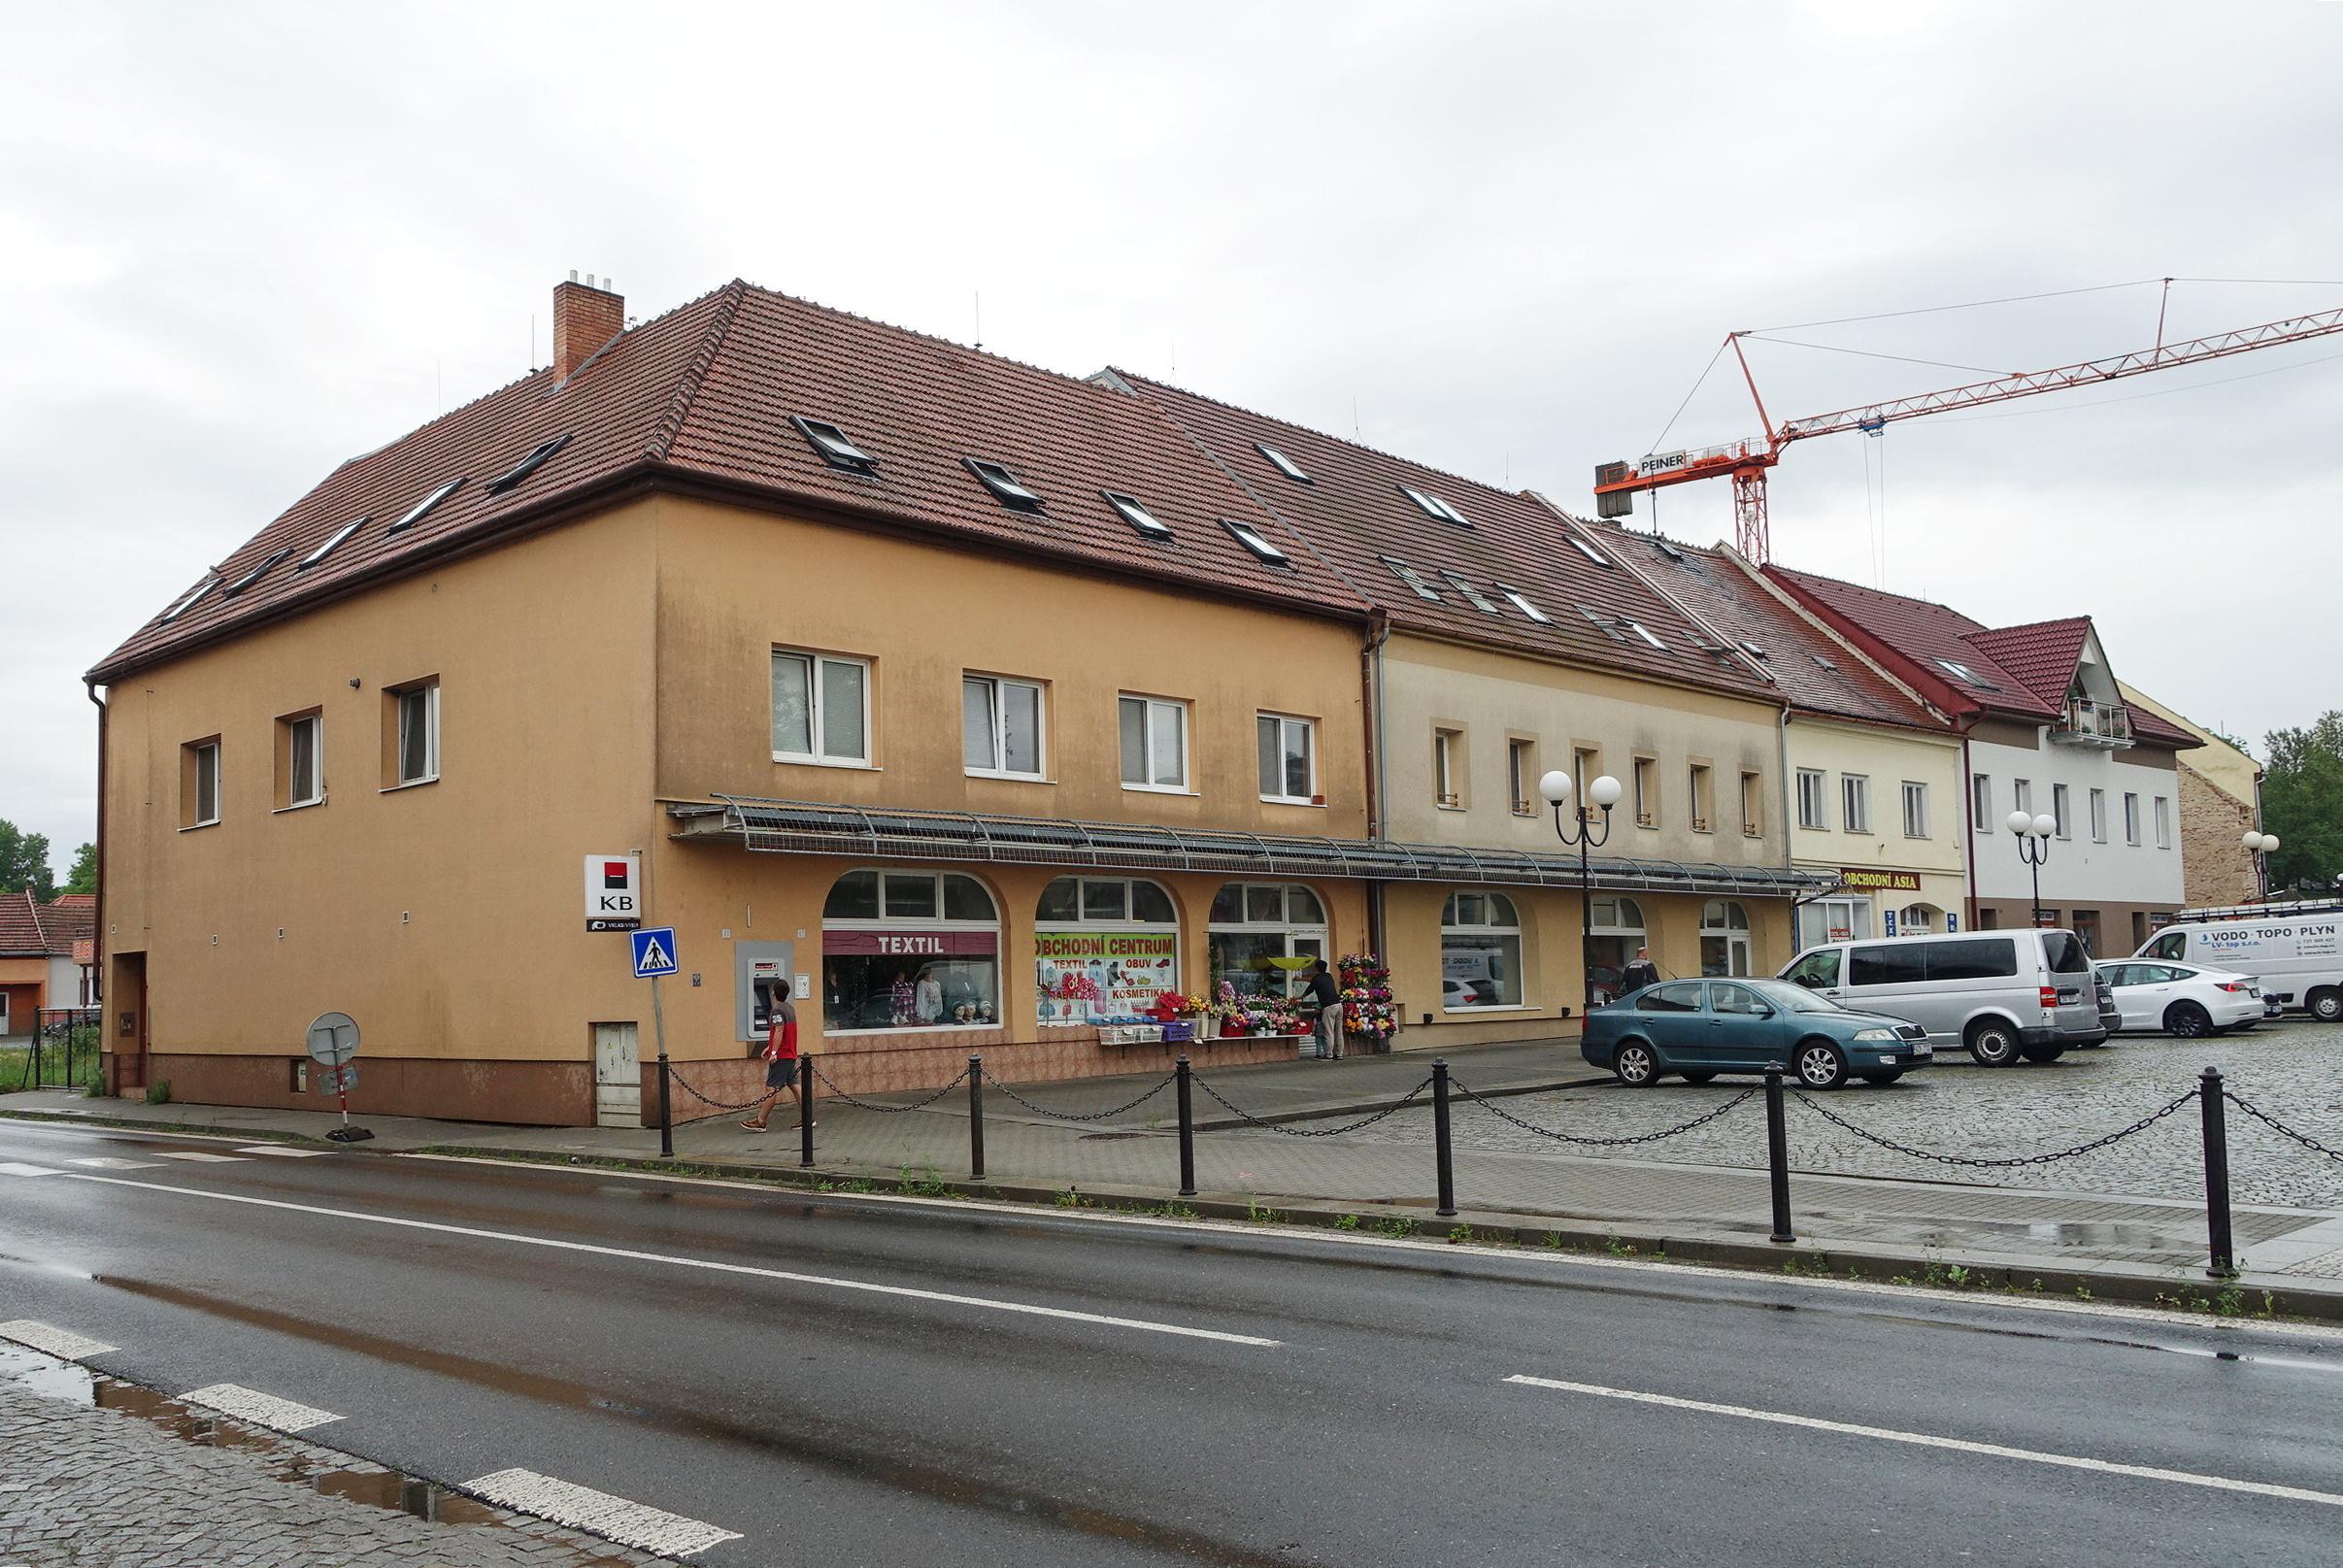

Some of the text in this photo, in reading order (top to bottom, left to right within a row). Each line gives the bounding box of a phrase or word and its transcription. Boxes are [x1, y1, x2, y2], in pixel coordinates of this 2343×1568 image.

[1641, 454, 1684, 472] PEINER
[1845, 872, 1917, 888] OBCHODNÍ ASIA
[600, 896, 633, 911] KB
[2212, 925, 2335, 941] VODO TOPO PLYN
[878, 937, 944, 953] TEXTIL
[1110, 939, 1172, 954] CENTRUM
[1054, 959, 1088, 969] TEXTIL
[1126, 959, 1152, 968] OBUV
[772, 1015, 783, 1023] 35
